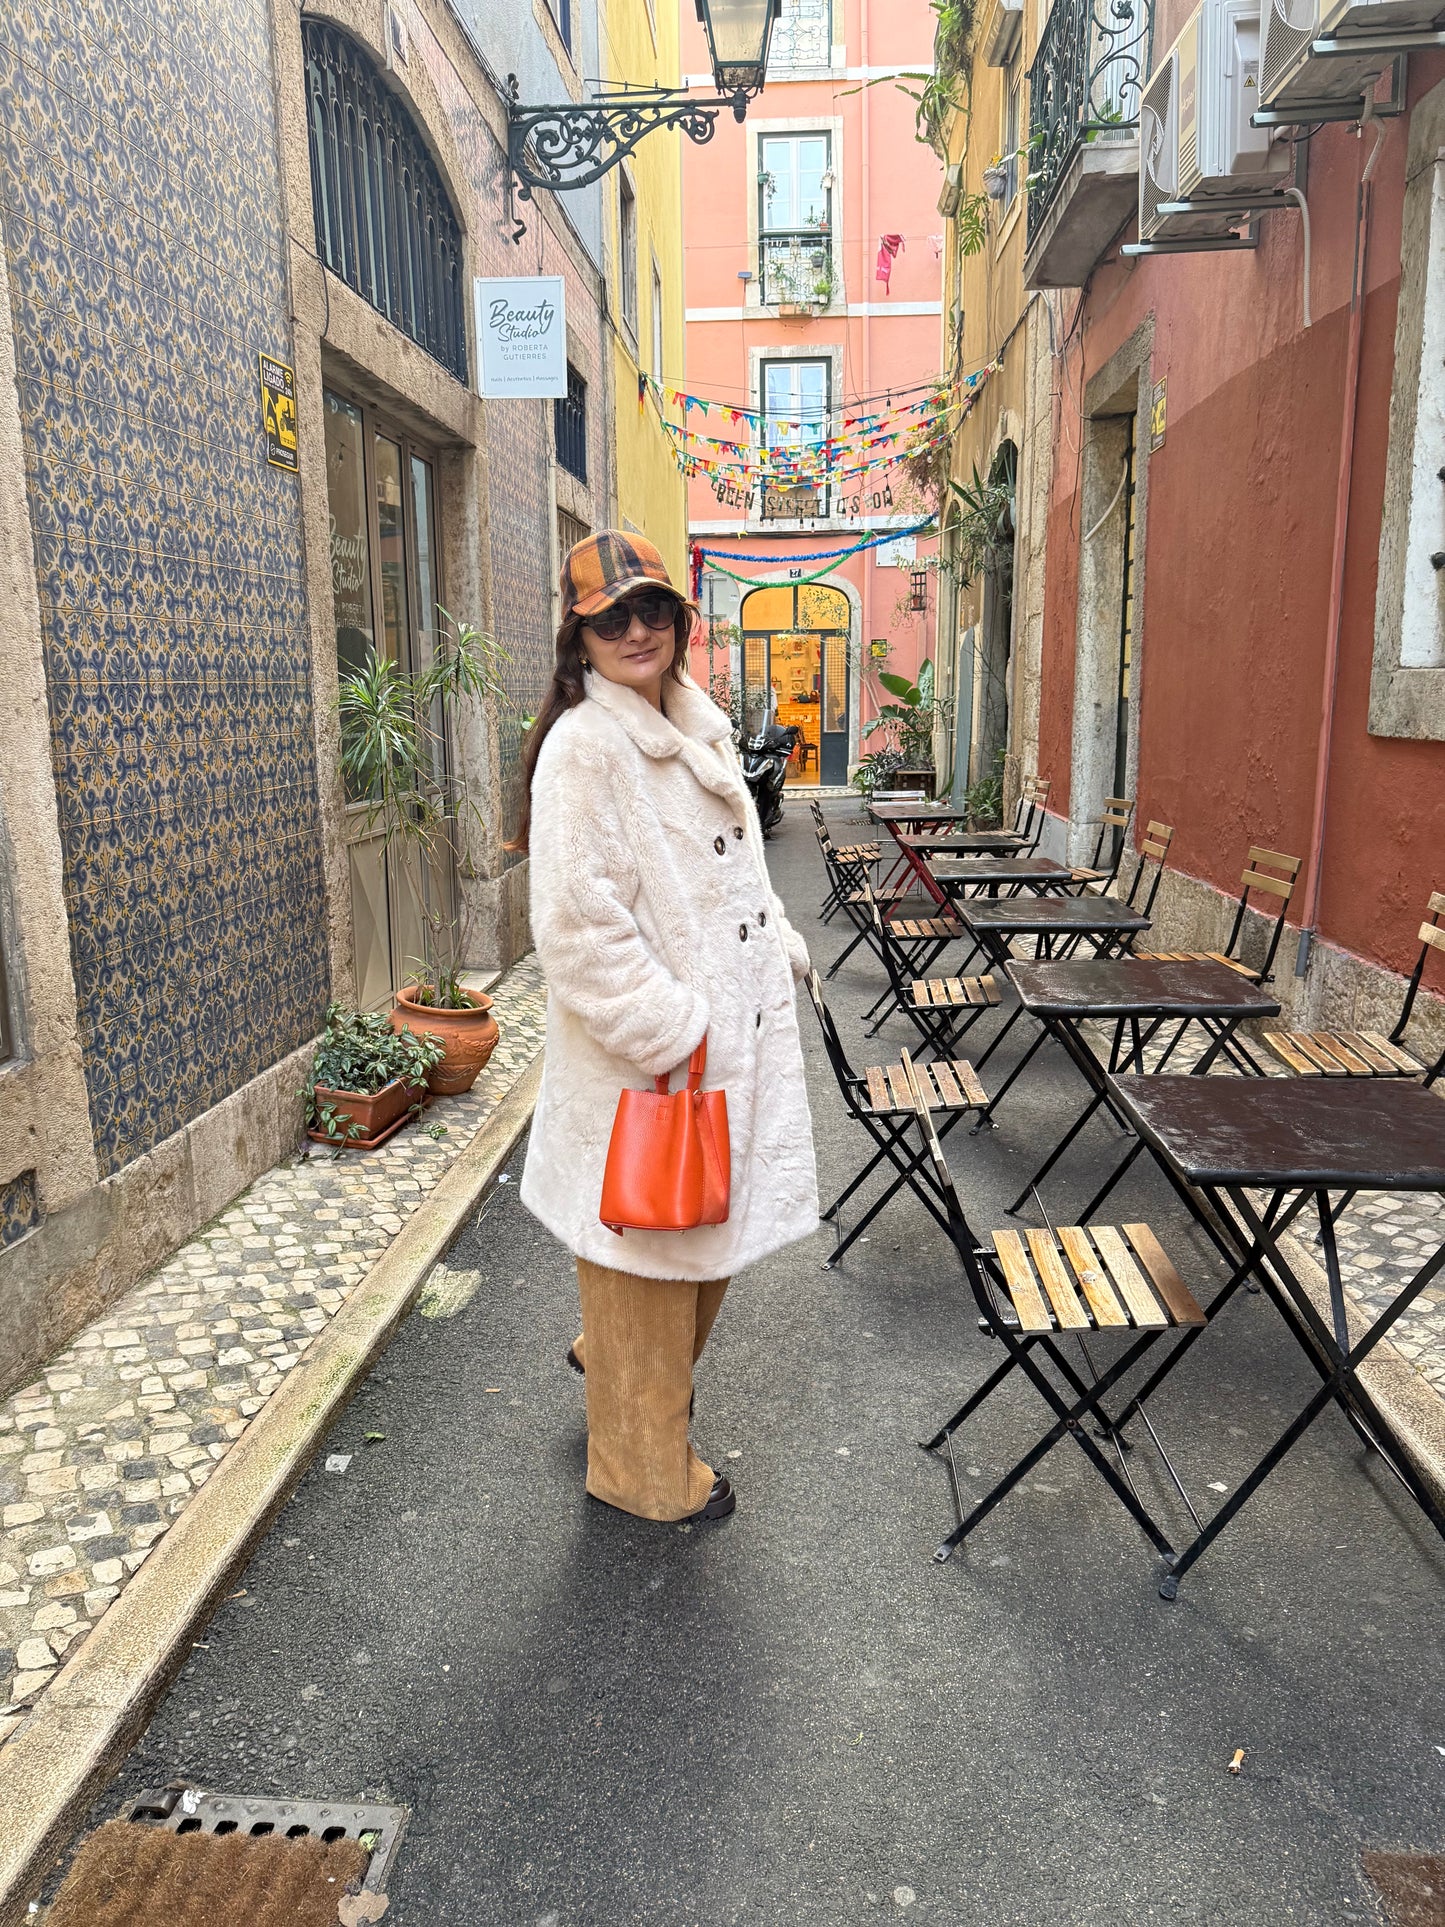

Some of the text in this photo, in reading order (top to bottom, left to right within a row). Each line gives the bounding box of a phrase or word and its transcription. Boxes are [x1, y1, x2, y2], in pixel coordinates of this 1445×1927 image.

[489, 299, 554, 335] Beauty
[498, 323, 540, 342] Studio
[501, 345, 509, 353] by
[263, 360, 284, 379] ALARME
[263, 370, 285, 390] LIGADO
[331, 559, 362, 594] Studio
[791, 569, 799, 577] 27
